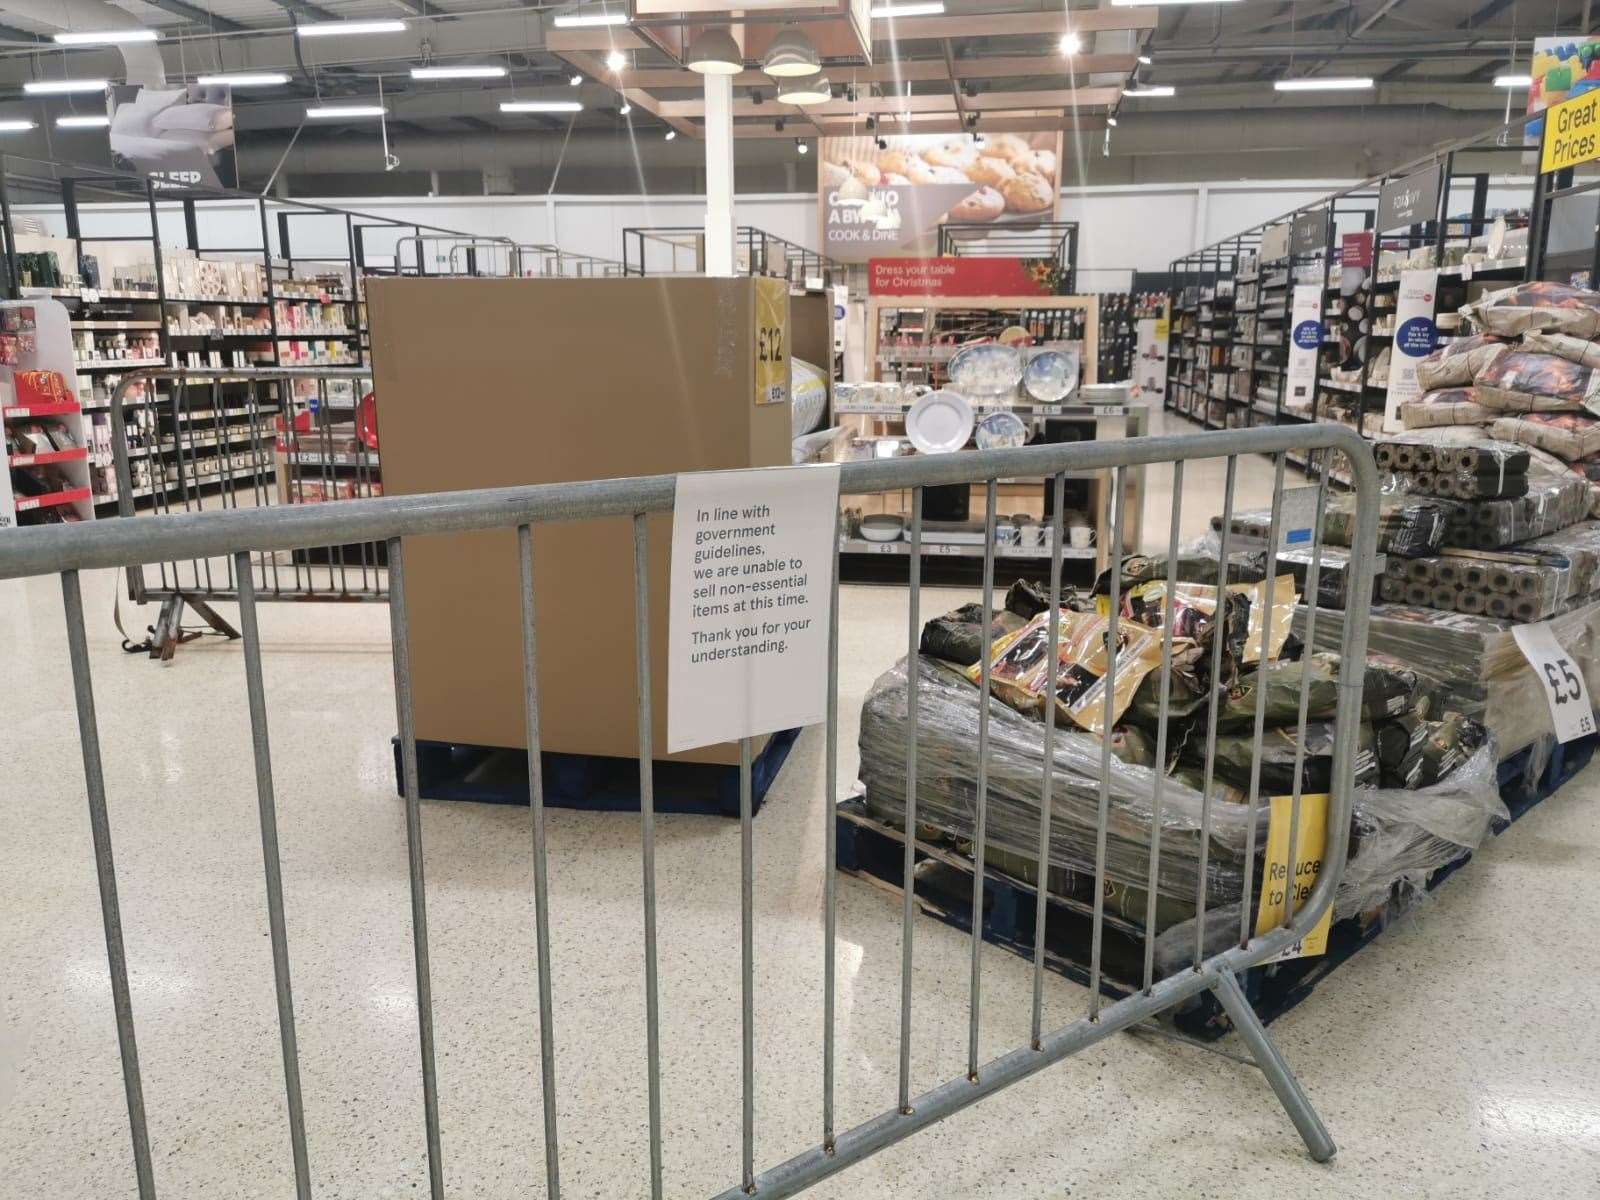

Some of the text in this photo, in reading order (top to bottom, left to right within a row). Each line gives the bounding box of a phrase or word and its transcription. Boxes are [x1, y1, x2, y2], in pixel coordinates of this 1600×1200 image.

[1558, 98, 1597, 134] Great
[1552, 134, 1595, 165] Prices
[828, 208, 841, 224] A
[828, 230, 899, 241] COOK & DINE
[875, 264, 956, 277] Dress your table
[875, 277, 942, 287] for Christmas
[760, 327, 782, 362] £12
[697, 504, 770, 522] In line with
[695, 524, 776, 545] government
[694, 544, 765, 564] guidelines,
[694, 558, 803, 580] we are unable to
[693, 573, 807, 599] sell non-essential
[692, 593, 808, 618] items at this time.
[691, 618, 811, 645] Thank you for your
[691, 639, 788, 664] understanding.
[1544, 659, 1581, 705] £5
[1580, 717, 1591, 732] £5
[1270, 859, 1321, 881] Reuce
[1268, 889, 1284, 906] to
